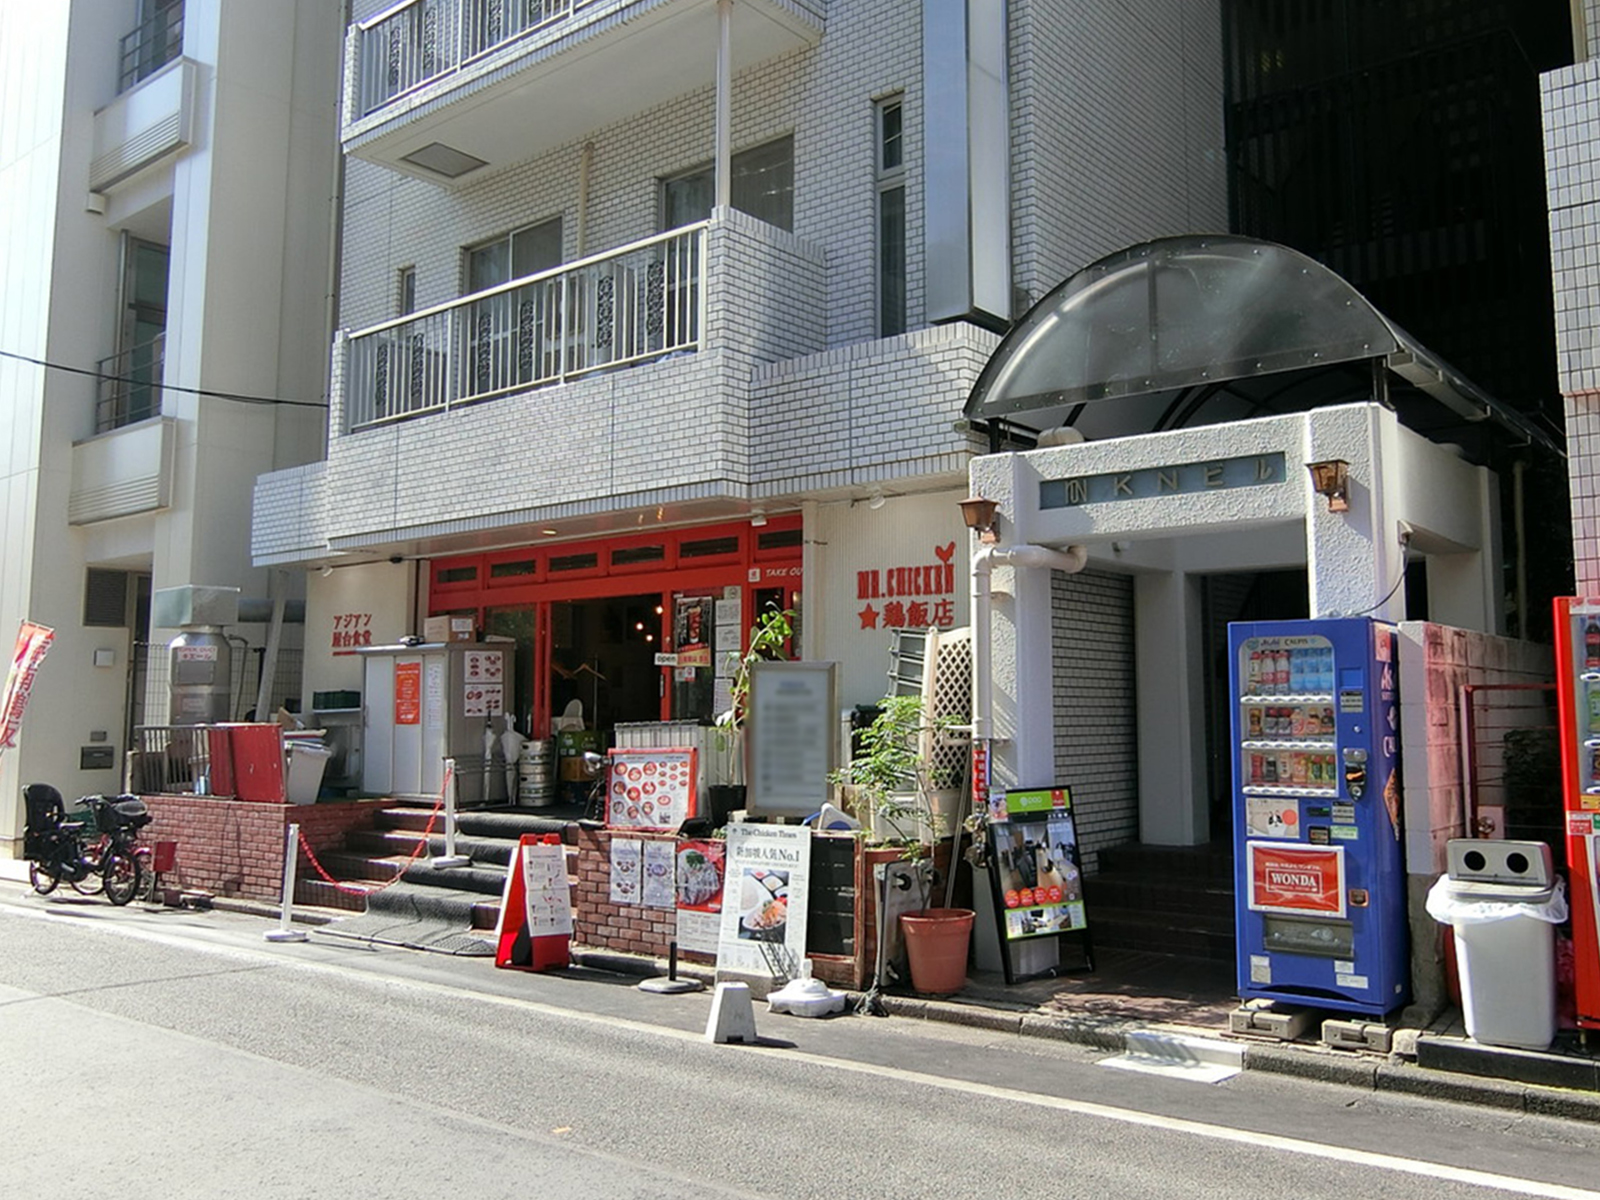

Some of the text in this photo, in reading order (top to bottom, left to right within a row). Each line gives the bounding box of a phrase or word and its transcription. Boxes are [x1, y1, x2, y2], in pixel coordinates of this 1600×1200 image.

[765, 567, 788, 577] TAKE
[789, 566, 803, 576] OU
[882, 598, 955, 629] 鶏飯店
[333, 613, 373, 630] アジアン
[331, 630, 372, 648] 屋台食堂
[657, 655, 677, 663] open
[741, 828, 797, 839] The Chicken Times
[1271, 872, 1317, 887] WONDA
